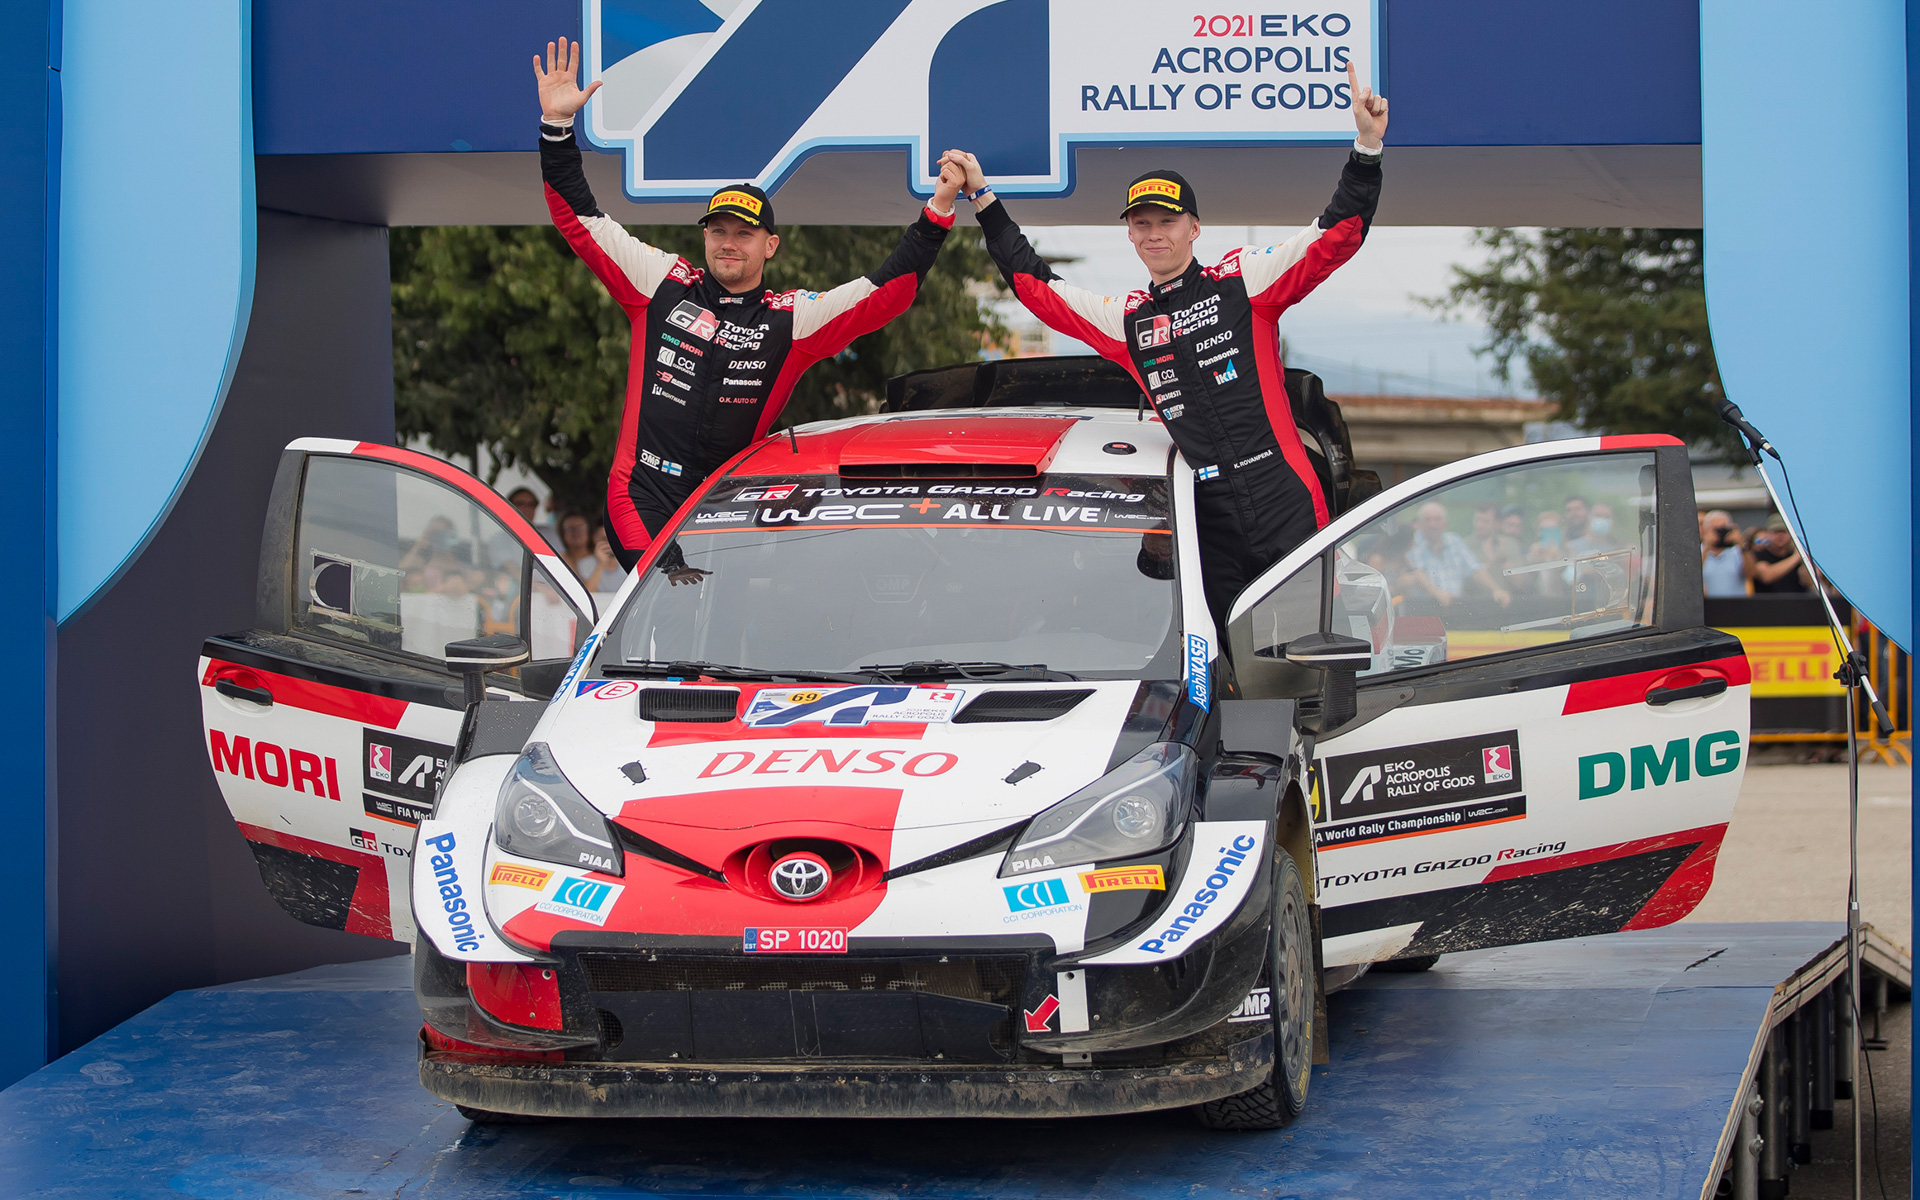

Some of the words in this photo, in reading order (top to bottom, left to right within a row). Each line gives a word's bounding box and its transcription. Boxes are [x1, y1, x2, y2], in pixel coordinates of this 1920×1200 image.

[1193, 14, 1253, 37] 2021
[1260, 13, 1351, 37] EKO
[1151, 46, 1350, 74] ACROPOLIS
[1081, 84, 1186, 111] RALLY
[1194, 83, 1242, 110] OF
[1251, 83, 1352, 110] GODS
[1131, 183, 1176, 198] PIRELLI
[1171, 294, 1221, 320] TOYOTA
[1171, 305, 1218, 330] GAZOO
[671, 310, 716, 339] GR
[1172, 315, 1219, 338] Racing
[1138, 326, 1168, 347] GR
[1196, 330, 1233, 353] DENSO
[680, 341, 703, 357] MORI
[1156, 354, 1174, 364] MORI
[1198, 347, 1239, 368] Panasonic
[677, 357, 696, 372] CCI
[728, 360, 767, 370] DENSO
[1161, 368, 1175, 380] CCI
[723, 377, 762, 386] Panasonic
[641, 452, 660, 466] OMP
[737, 489, 790, 500] GR
[802, 486, 919, 497] TOYOTA
[927, 485, 1037, 496] GAZOO
[1043, 487, 1146, 503] Racing
[943, 503, 1011, 520] ALL
[1022, 505, 1101, 523] LIVE
[604, 685, 629, 696] E
[792, 693, 818, 702] 69
[209, 729, 341, 801] MORI
[698, 749, 958, 778] DENSO
[1384, 760, 1415, 773] EKO
[1578, 729, 1741, 800] DMG
[376, 771, 389, 780] EKO
[1385, 766, 1451, 785] ACROPOLIS
[1492, 772, 1510, 780] EKO
[1387, 781, 1421, 798] RALLY
[1423, 779, 1440, 792] OF
[1442, 775, 1475, 789] GODS
[397, 806, 411, 818] FIA
[1325, 827, 1356, 841] World
[1358, 821, 1385, 837] Rally
[1388, 810, 1461, 831] Championship
[351, 835, 377, 851] GR
[381, 842, 412, 858] TOY
[578, 852, 612, 870] PIAA
[1011, 855, 1055, 872] PIAA
[1320, 866, 1407, 888] TOYOTA
[1413, 854, 1492, 874] GAZOO
[1496, 841, 1567, 861] Racing
[492, 865, 548, 887] PIRELLI
[1084, 868, 1159, 889] PIRELLI
[425, 832, 485, 952] Panasonic
[1137, 834, 1256, 954] Panasonic
[540, 902, 554, 910] CCI
[555, 905, 604, 923] CORPORATION
[1003, 915, 1019, 924] CCI
[1021, 904, 1083, 920] CORPORATION
[759, 930, 790, 950] SP
[798, 930, 844, 950] 1020
